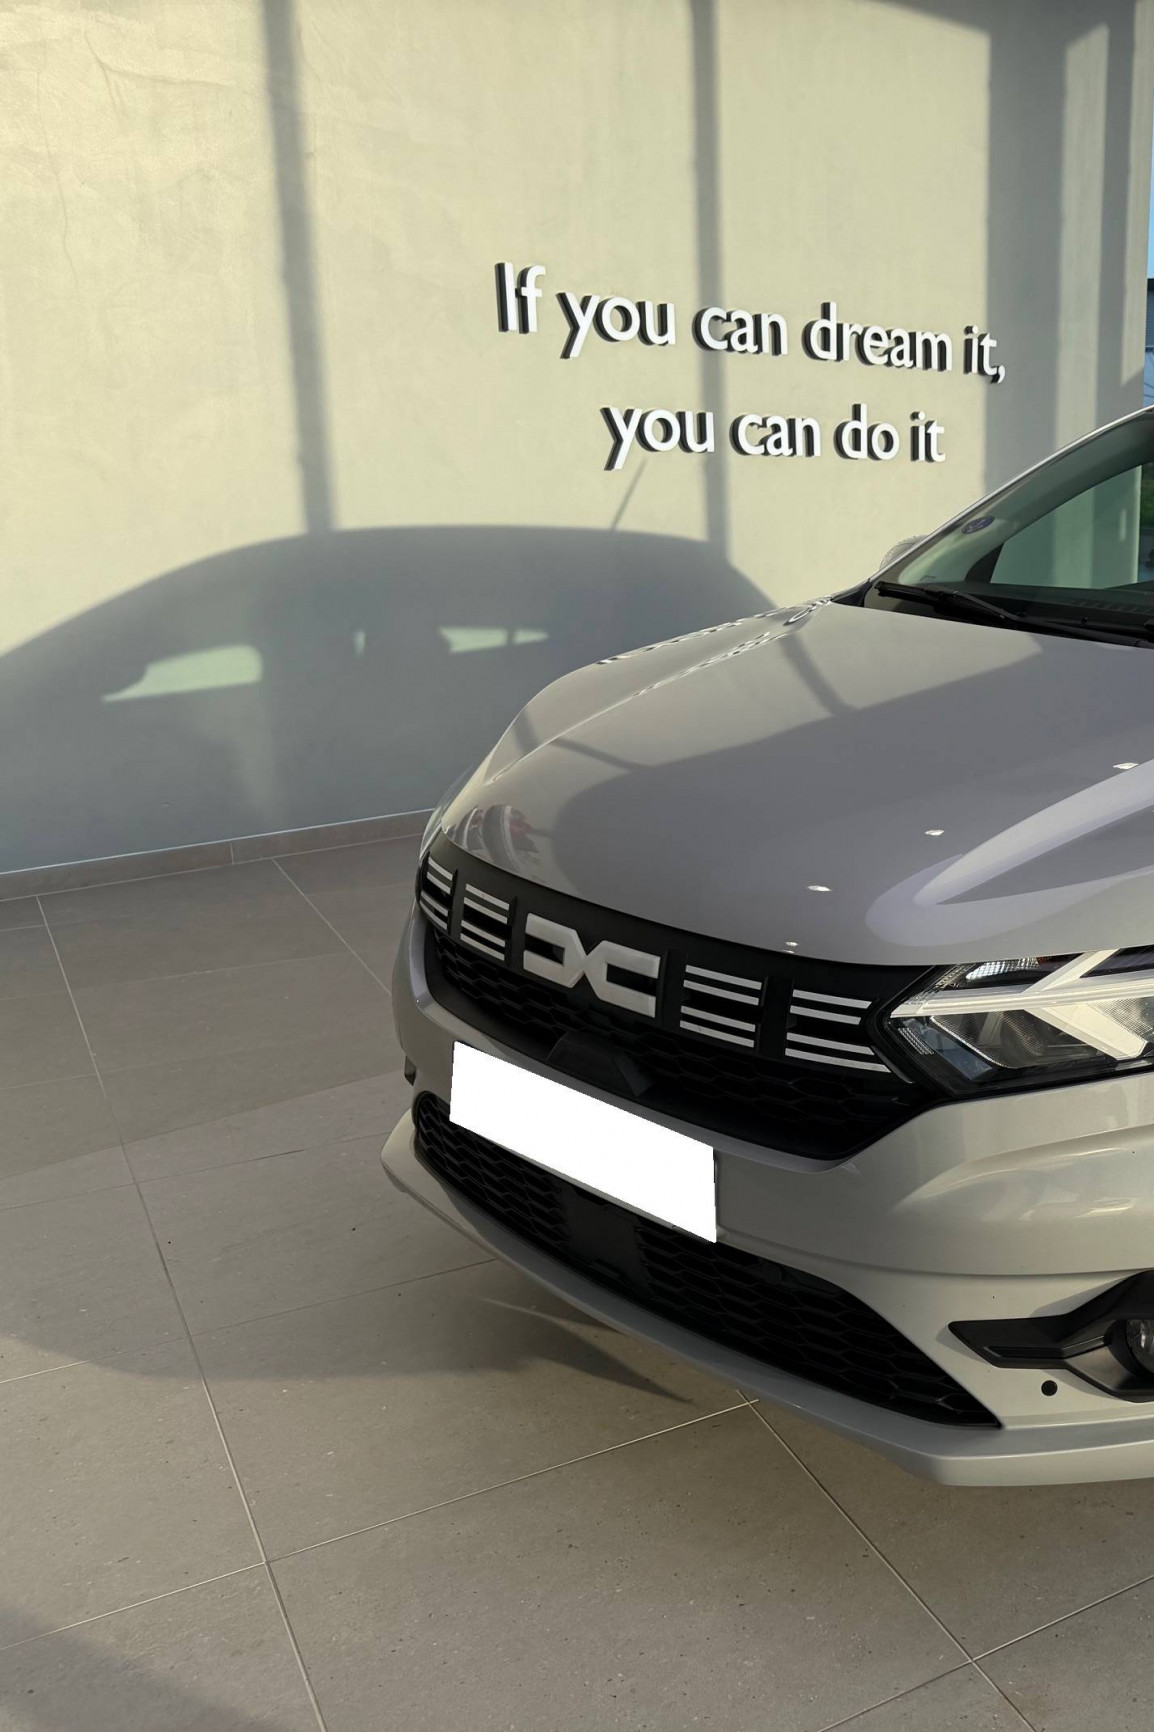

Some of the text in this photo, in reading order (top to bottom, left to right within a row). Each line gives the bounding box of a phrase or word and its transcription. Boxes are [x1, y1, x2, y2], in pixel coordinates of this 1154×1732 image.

[494, 262, 1006, 384] If you can dream it,
[601, 402, 946, 471] you can do it
